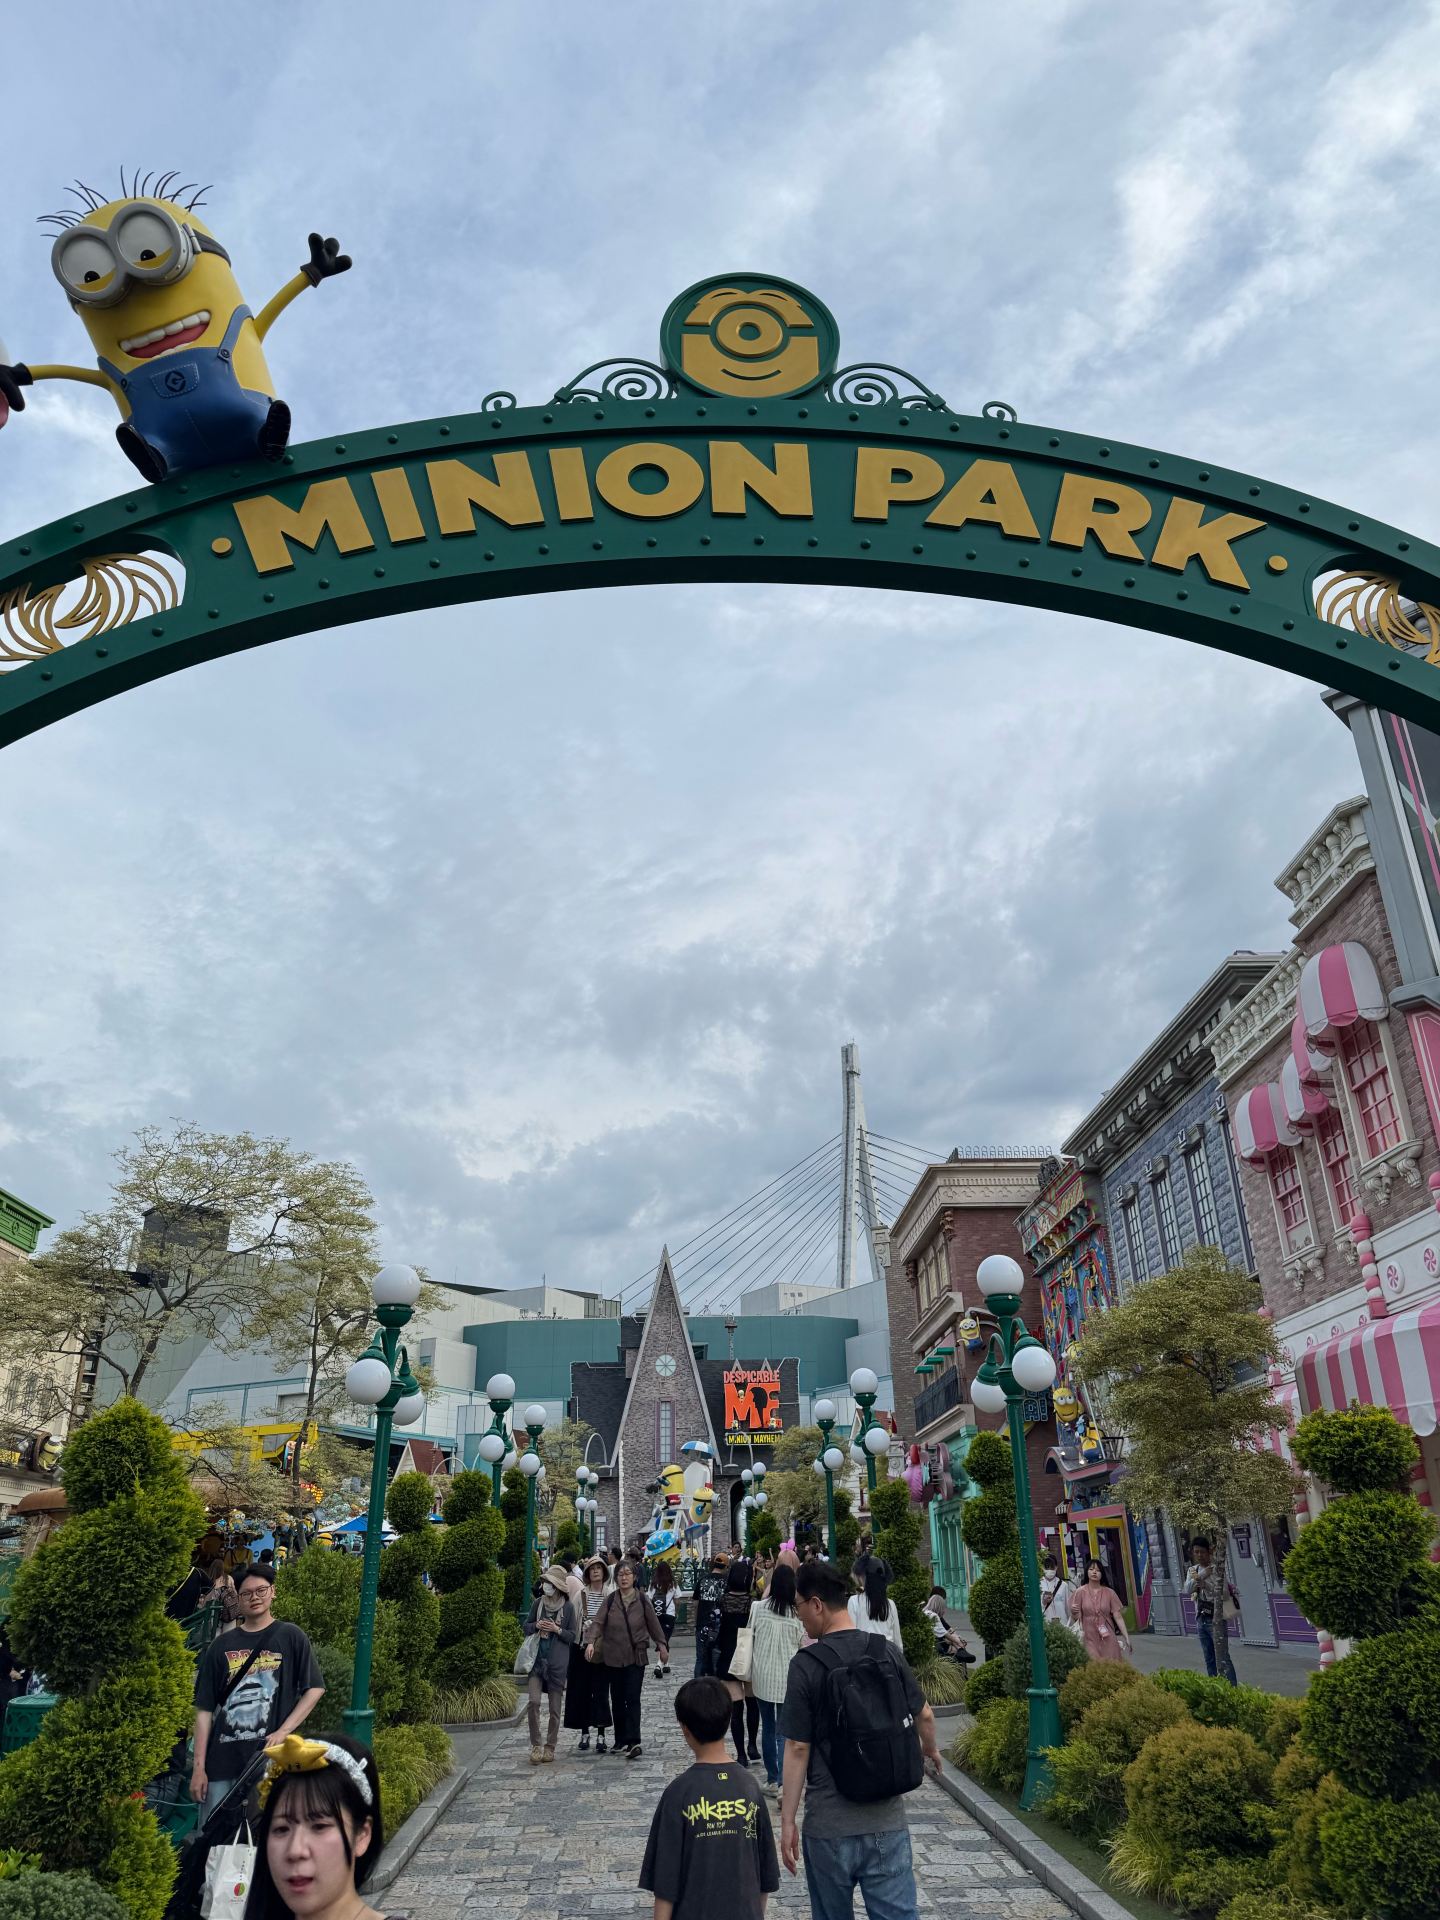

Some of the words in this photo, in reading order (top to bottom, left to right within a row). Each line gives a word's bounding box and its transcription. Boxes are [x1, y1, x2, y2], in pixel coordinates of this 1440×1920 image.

[233, 441, 813, 576] MINION
[853, 446, 1268, 592] PARK
[723, 1370, 780, 1383] DESPICABLE
[724, 1382, 783, 1430] ME
[682, 1796, 747, 1826] YANKEES
